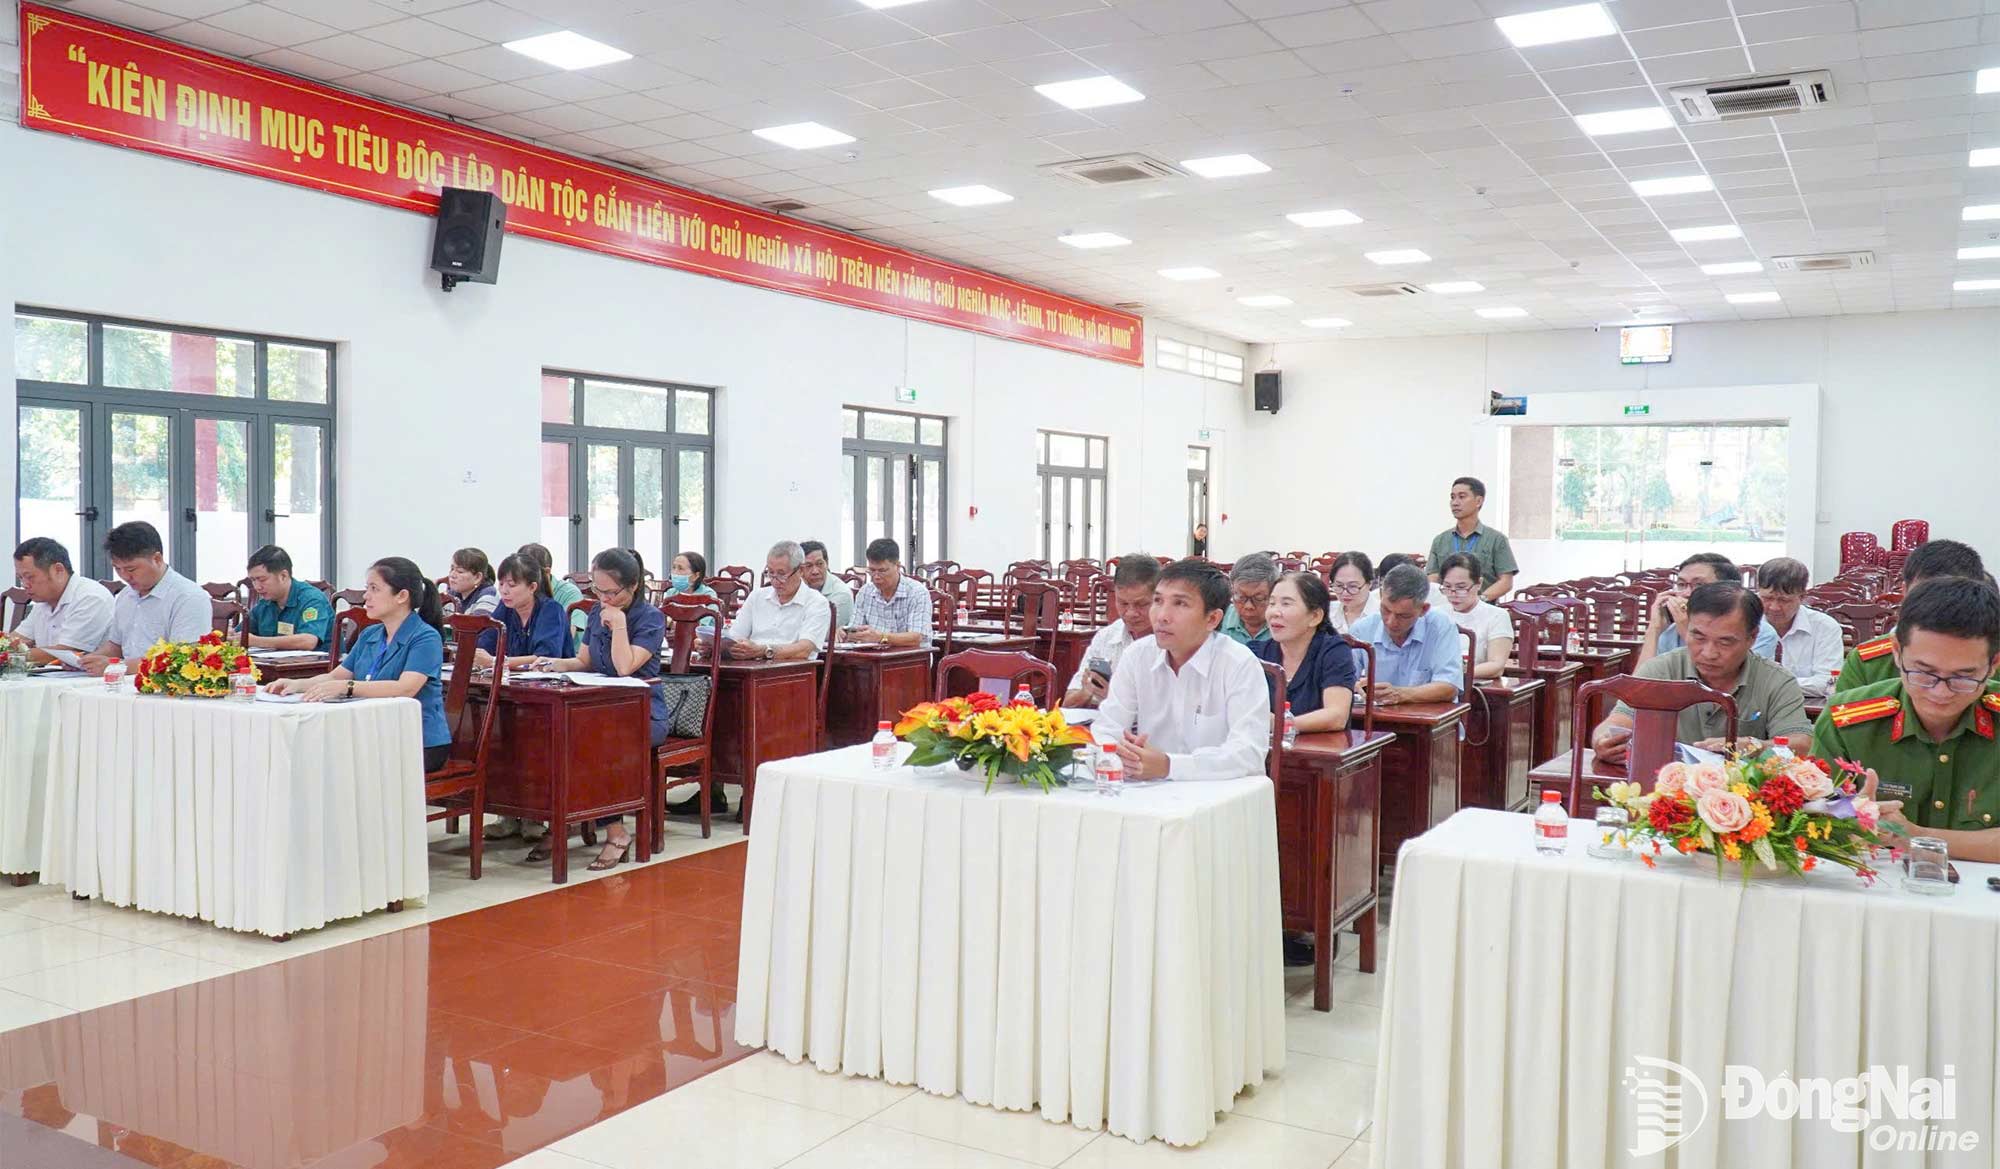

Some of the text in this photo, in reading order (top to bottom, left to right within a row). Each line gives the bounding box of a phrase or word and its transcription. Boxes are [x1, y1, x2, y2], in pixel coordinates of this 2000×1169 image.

[176, 84, 250, 141] ĐỊNH
[261, 106, 324, 163] MỤC
[332, 124, 389, 174] TIÊU
[396, 140, 445, 192] ĐỘC
[502, 166, 545, 212] DÂN
[551, 178, 588, 226] TỘC
[594, 186, 632, 233] GẮN
[637, 200, 675, 243] LIỀN
[680, 213, 706, 251] VỚI
[711, 220, 742, 259] CHỦ
[745, 233, 790, 271] NGHĨA
[794, 242, 812, 275] XÃ
[816, 247, 838, 286] HỘI
[841, 256, 873, 289] TRÊN
[903, 266, 931, 303] TẢNG
[934, 276, 955, 309] CHỦ
[957, 287, 987, 316] NGHĨA
[1046, 309, 1057, 333] TƯ
[1058, 309, 1084, 340] TƯỞNG
[1097, 321, 1111, 345] CHÍ
